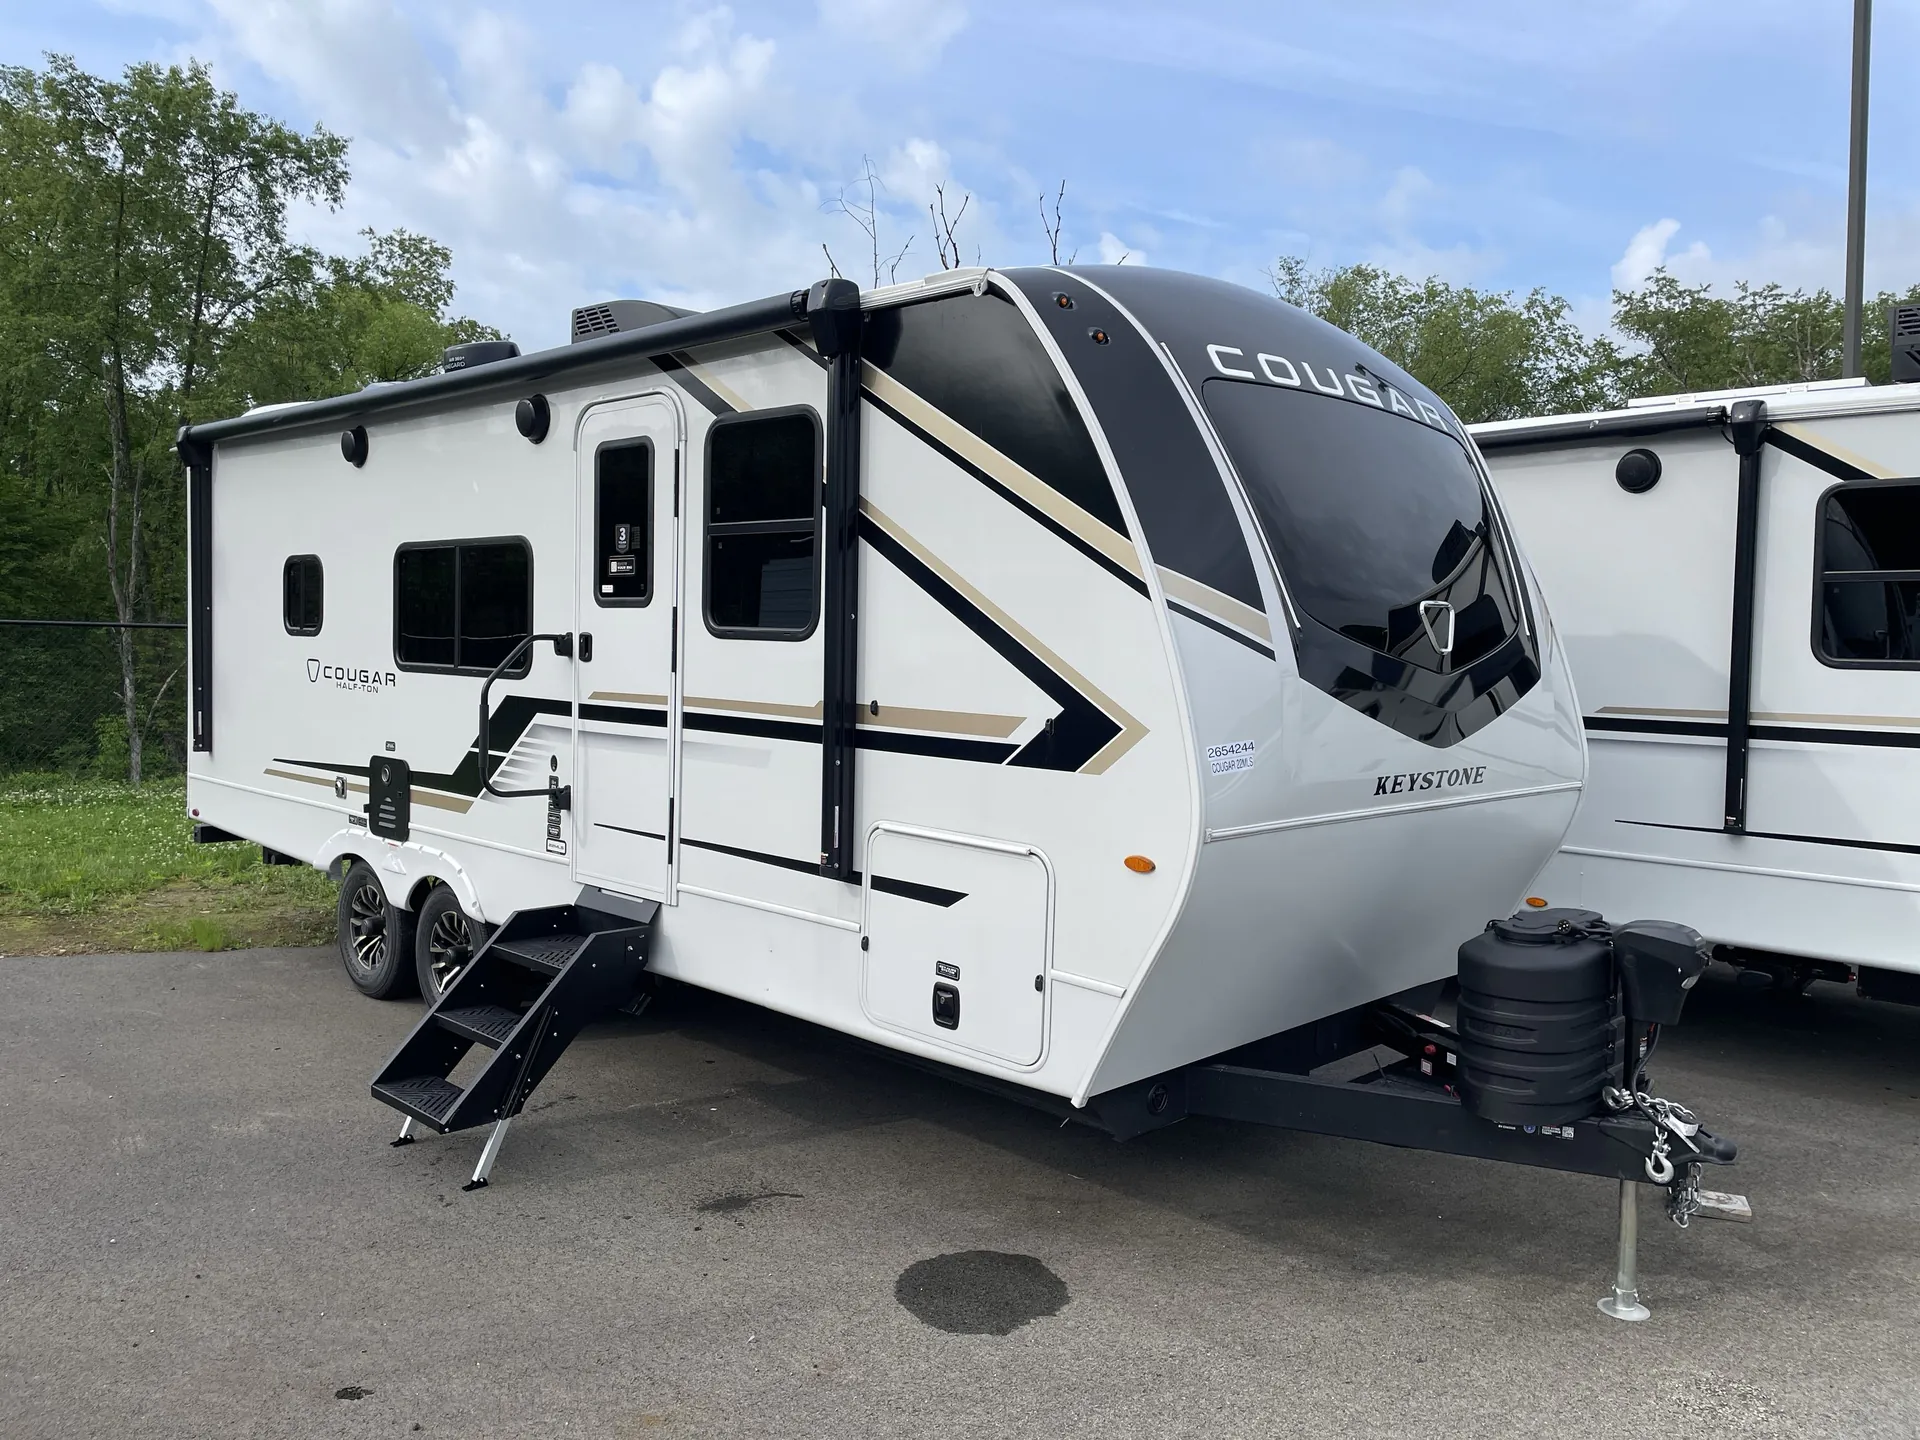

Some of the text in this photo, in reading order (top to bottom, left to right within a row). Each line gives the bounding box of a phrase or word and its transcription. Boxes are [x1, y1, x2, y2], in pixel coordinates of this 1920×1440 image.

[1206, 343, 1448, 432] COUGAR
[619, 527, 626, 541] 3
[323, 665, 396, 687] COUGAR
[336, 681, 379, 693] HALF-TON
[1207, 741, 1255, 758] 2654244
[1211, 760, 1236, 774] COUGAR
[1373, 766, 1487, 796] KEYSTONE
